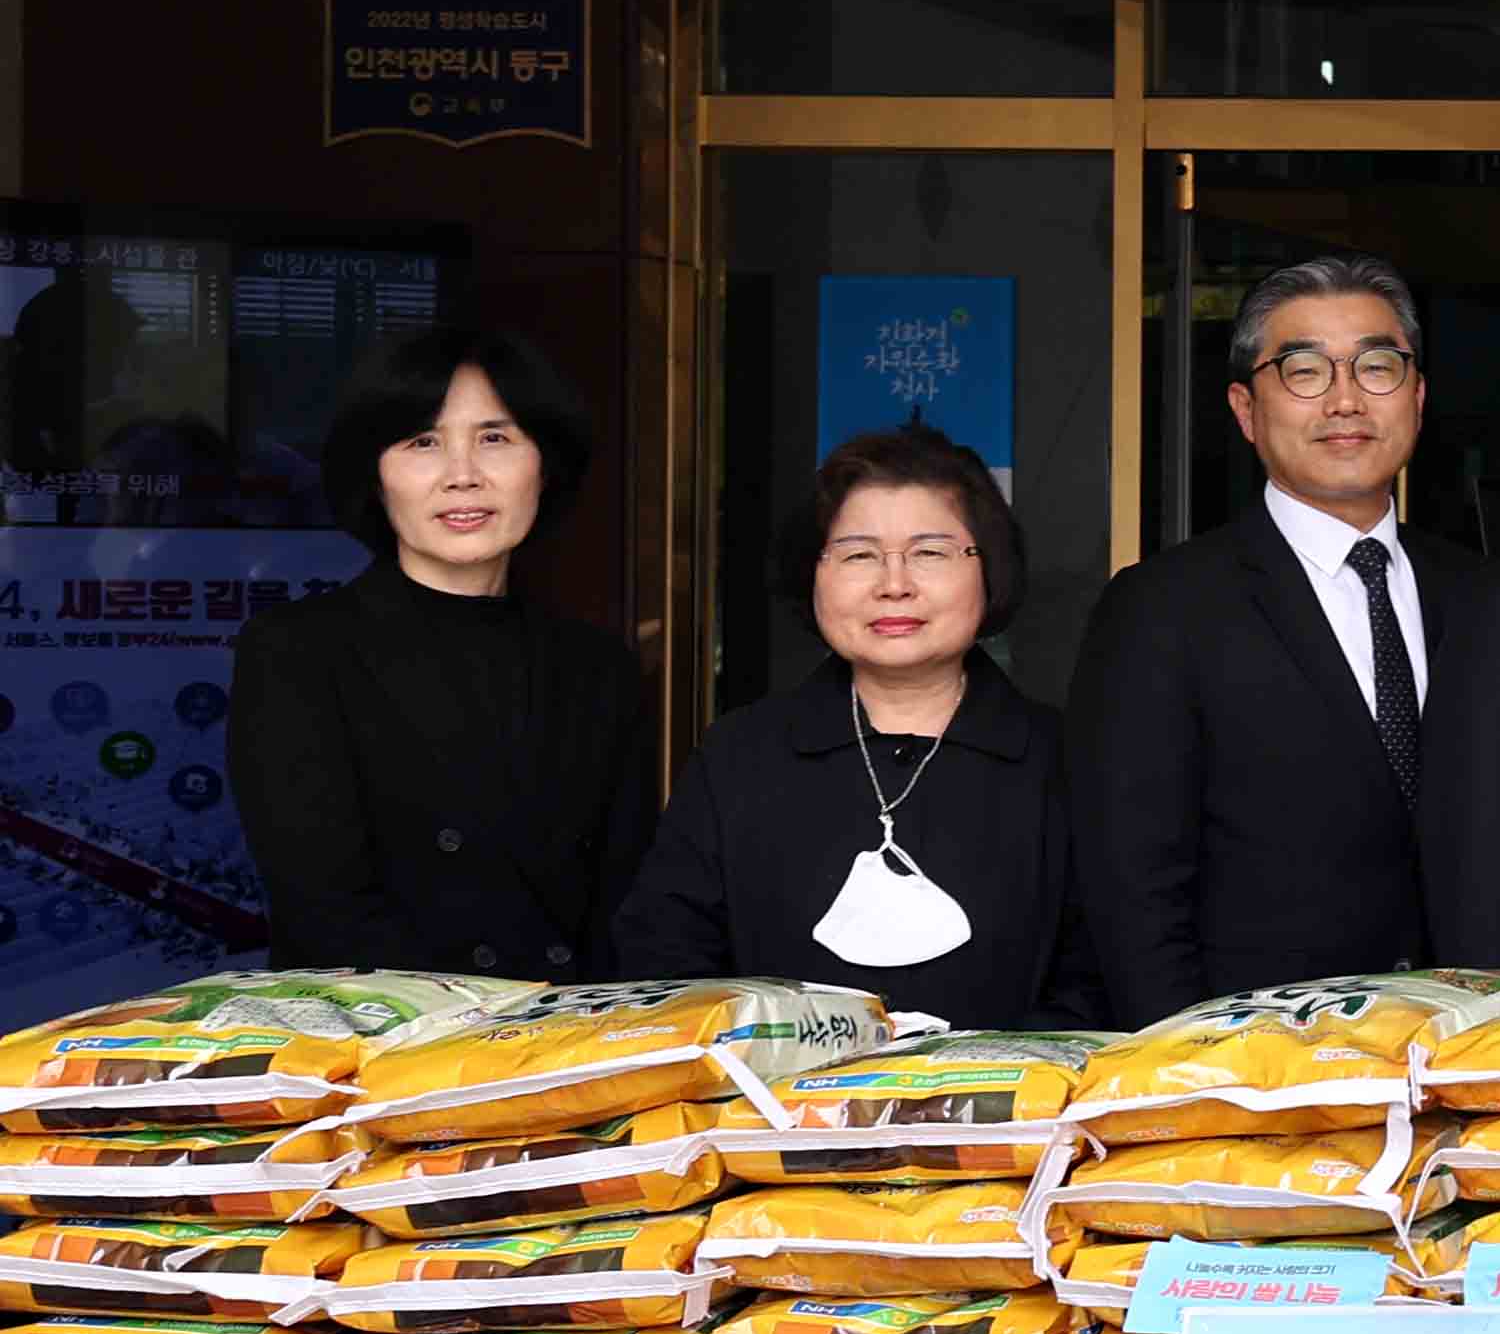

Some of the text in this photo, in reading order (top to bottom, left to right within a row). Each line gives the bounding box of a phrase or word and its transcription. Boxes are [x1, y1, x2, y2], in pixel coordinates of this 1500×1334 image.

[367, 11, 431, 30] 2022년
[345, 46, 569, 82] 인천광역시 동구
[57, 579, 193, 622] 새로운
[802, 1077, 839, 1088] NH
[1159, 1279, 1343, 1305] 사랑의 쌀 나눔
[801, 1303, 836, 1314] NH
